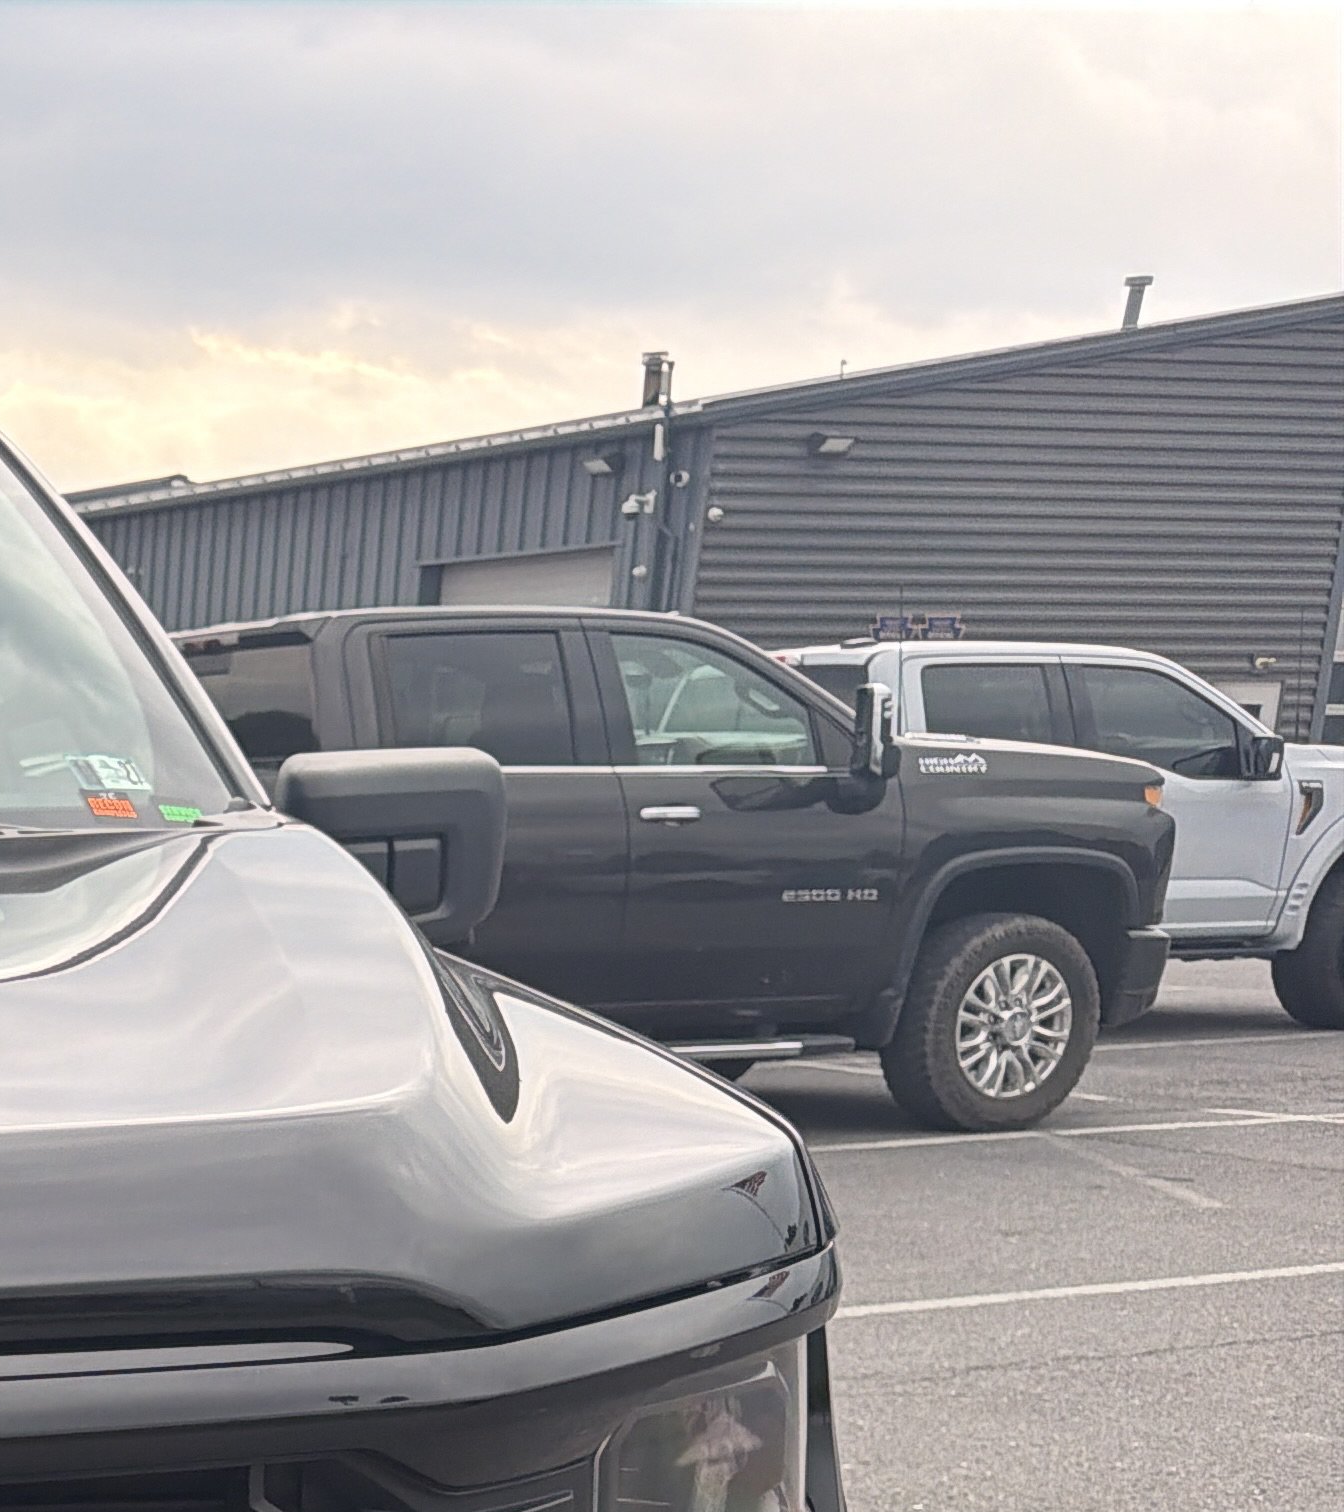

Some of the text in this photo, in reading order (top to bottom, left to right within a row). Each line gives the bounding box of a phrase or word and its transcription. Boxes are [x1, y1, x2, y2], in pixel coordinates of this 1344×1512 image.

[919, 764, 988, 774] COUNTRY
[781, 888, 879, 902] 2500 HD
